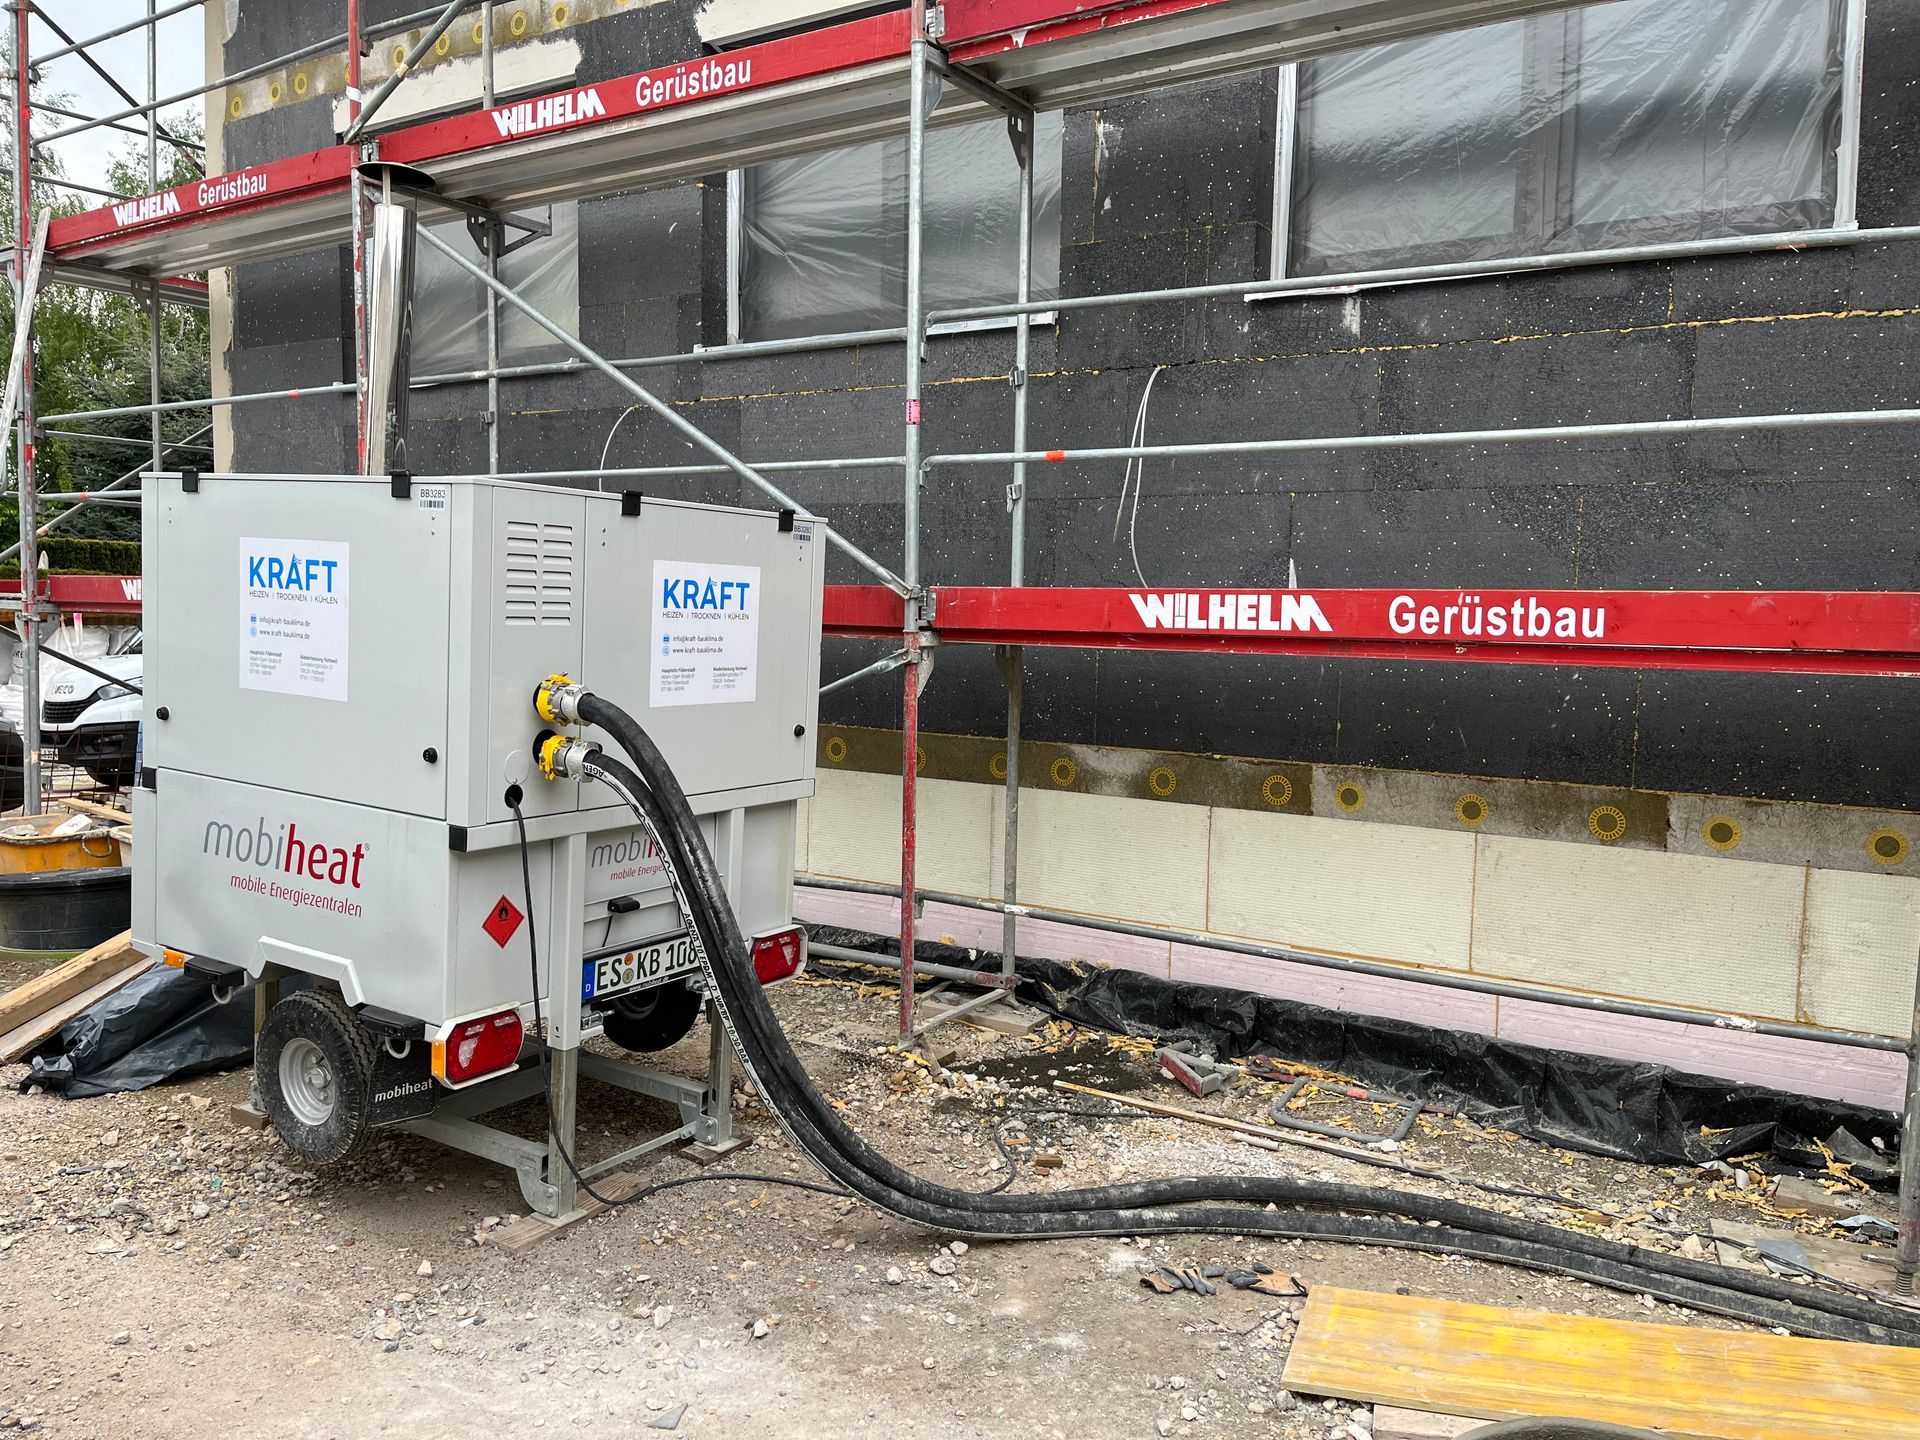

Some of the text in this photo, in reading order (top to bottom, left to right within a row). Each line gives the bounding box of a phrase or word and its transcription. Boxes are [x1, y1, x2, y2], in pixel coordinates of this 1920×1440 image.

[491, 58, 751, 137] WILHELM Gerüstbau
[112, 172, 267, 227] WILHELM Gerüstbau
[250, 553, 337, 593] KRAFT
[663, 576, 750, 610] KRAFT
[249, 590, 338, 605] HEIZEN TROCKNEN KÜHLEN
[662, 611, 749, 621] HEIZEN TROCKNEN KÜHLEN
[1128, 593, 1605, 638] WILHELM Gerüstbau
[583, 764, 604, 778] AGEN
[610, 867, 637, 881] mobile
[230, 874, 362, 918] mobile Energiezentralen
[585, 983, 591, 993] D
[596, 957, 622, 991] ES
[636, 948, 661, 980] KB
[684, 913, 700, 942] AGENA
[700, 955, 713, 979] EPDM
[736, 1048, 750, 1064] BAR
[374, 1078, 433, 1103] mobiheat
